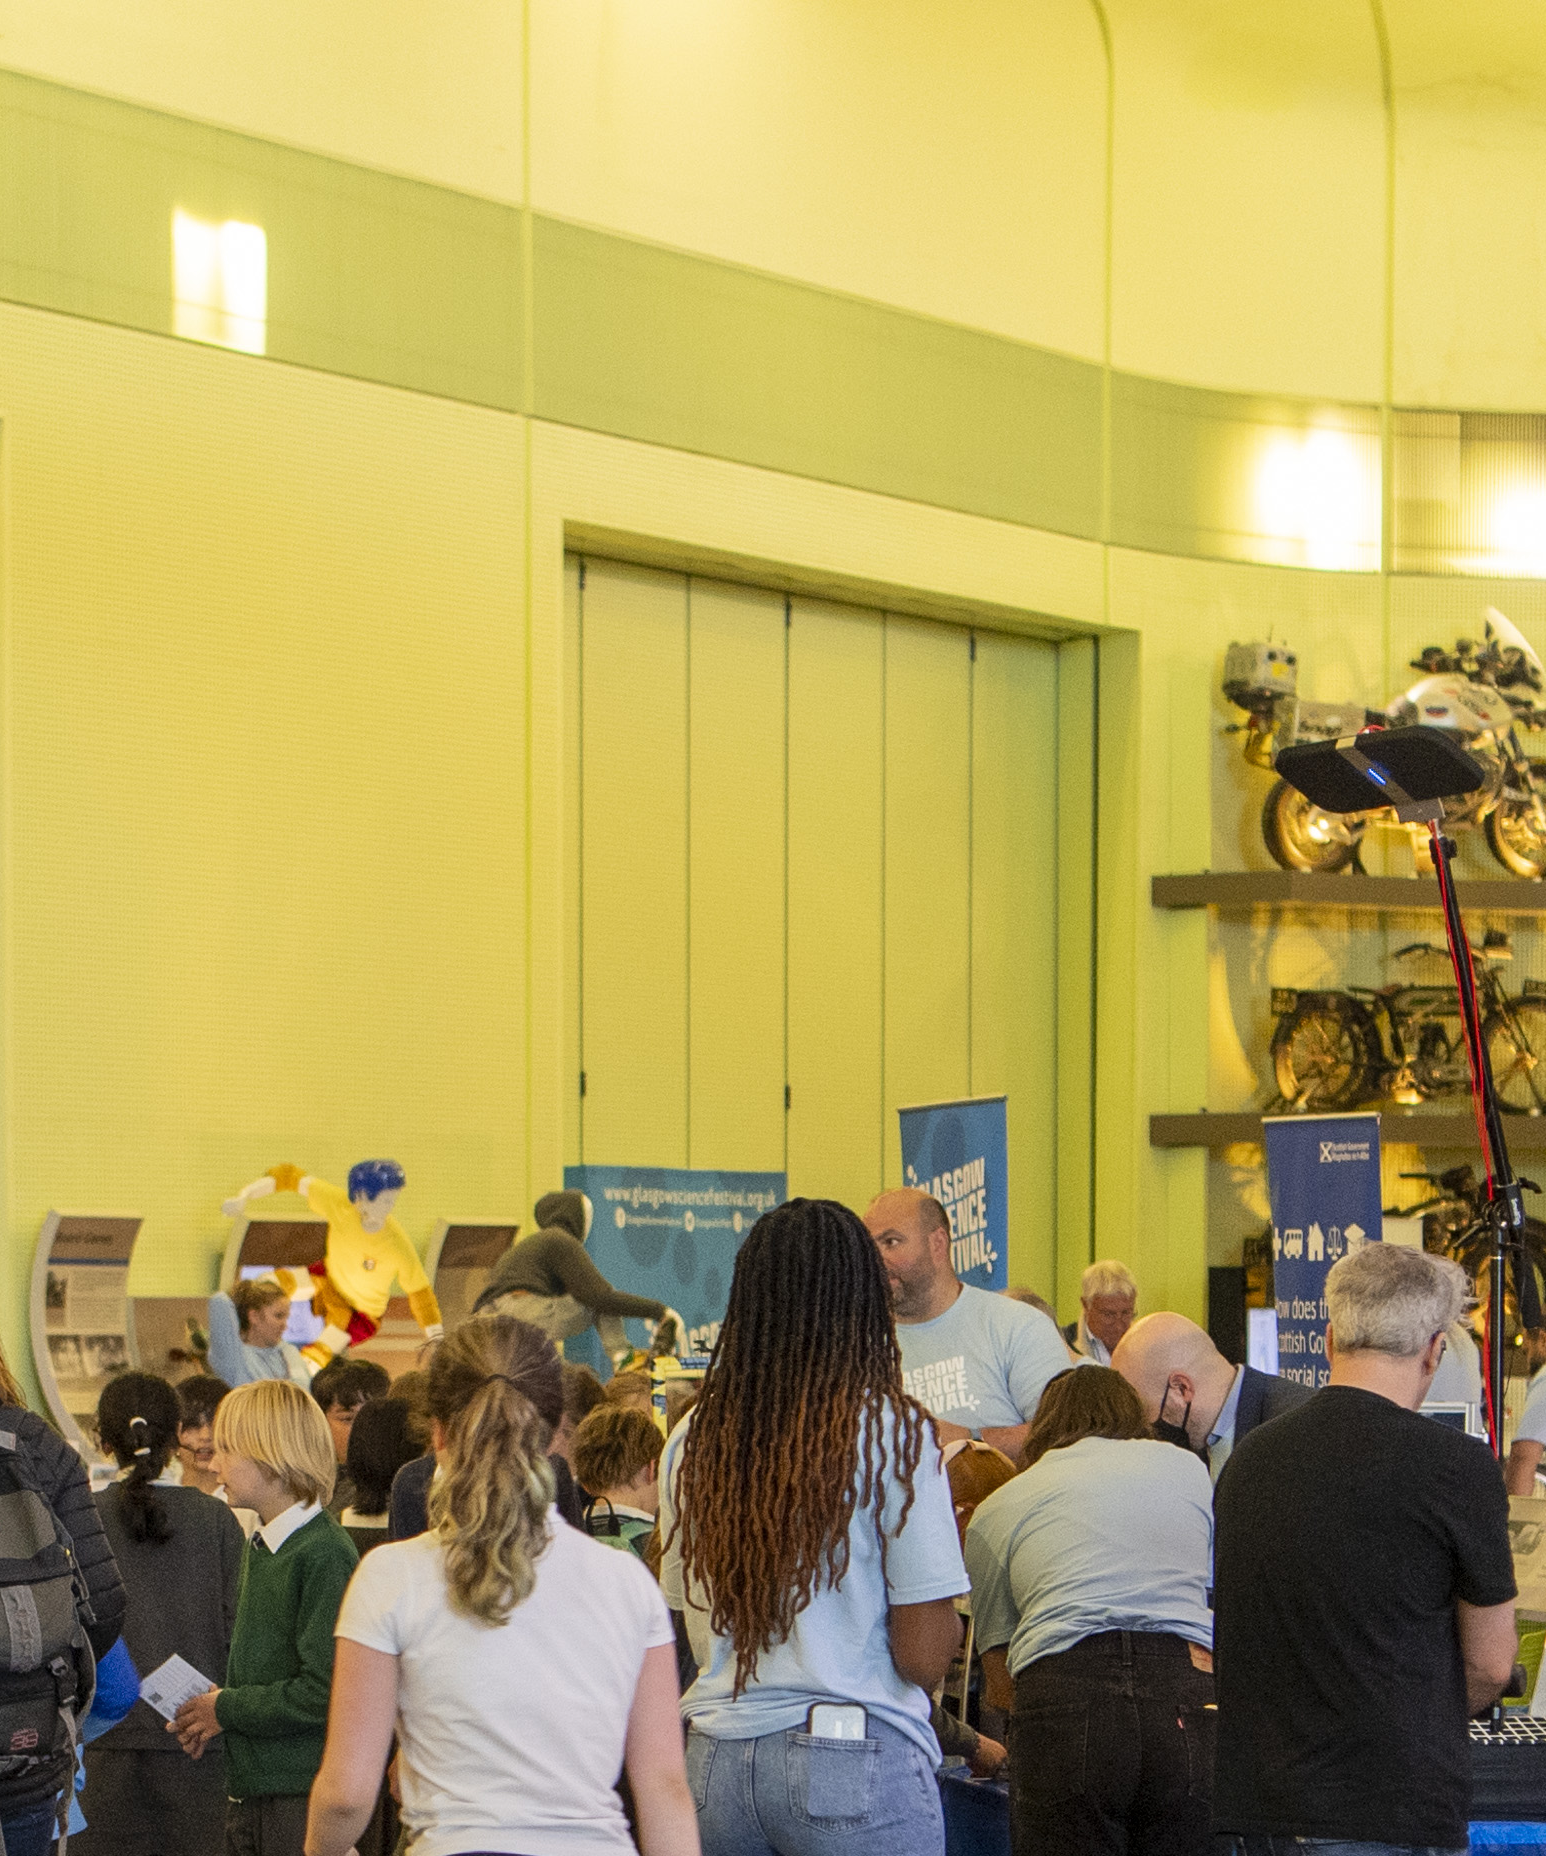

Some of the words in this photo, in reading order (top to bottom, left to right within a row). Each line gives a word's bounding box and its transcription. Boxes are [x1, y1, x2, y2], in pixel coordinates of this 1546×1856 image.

[945, 1188, 987, 1239] ENCE
[1291, 1295, 1317, 1320] does
[903, 1355, 964, 1386] ASGOW
[908, 1370, 968, 1401] IENCE
[925, 1390, 970, 1415] IVAL
